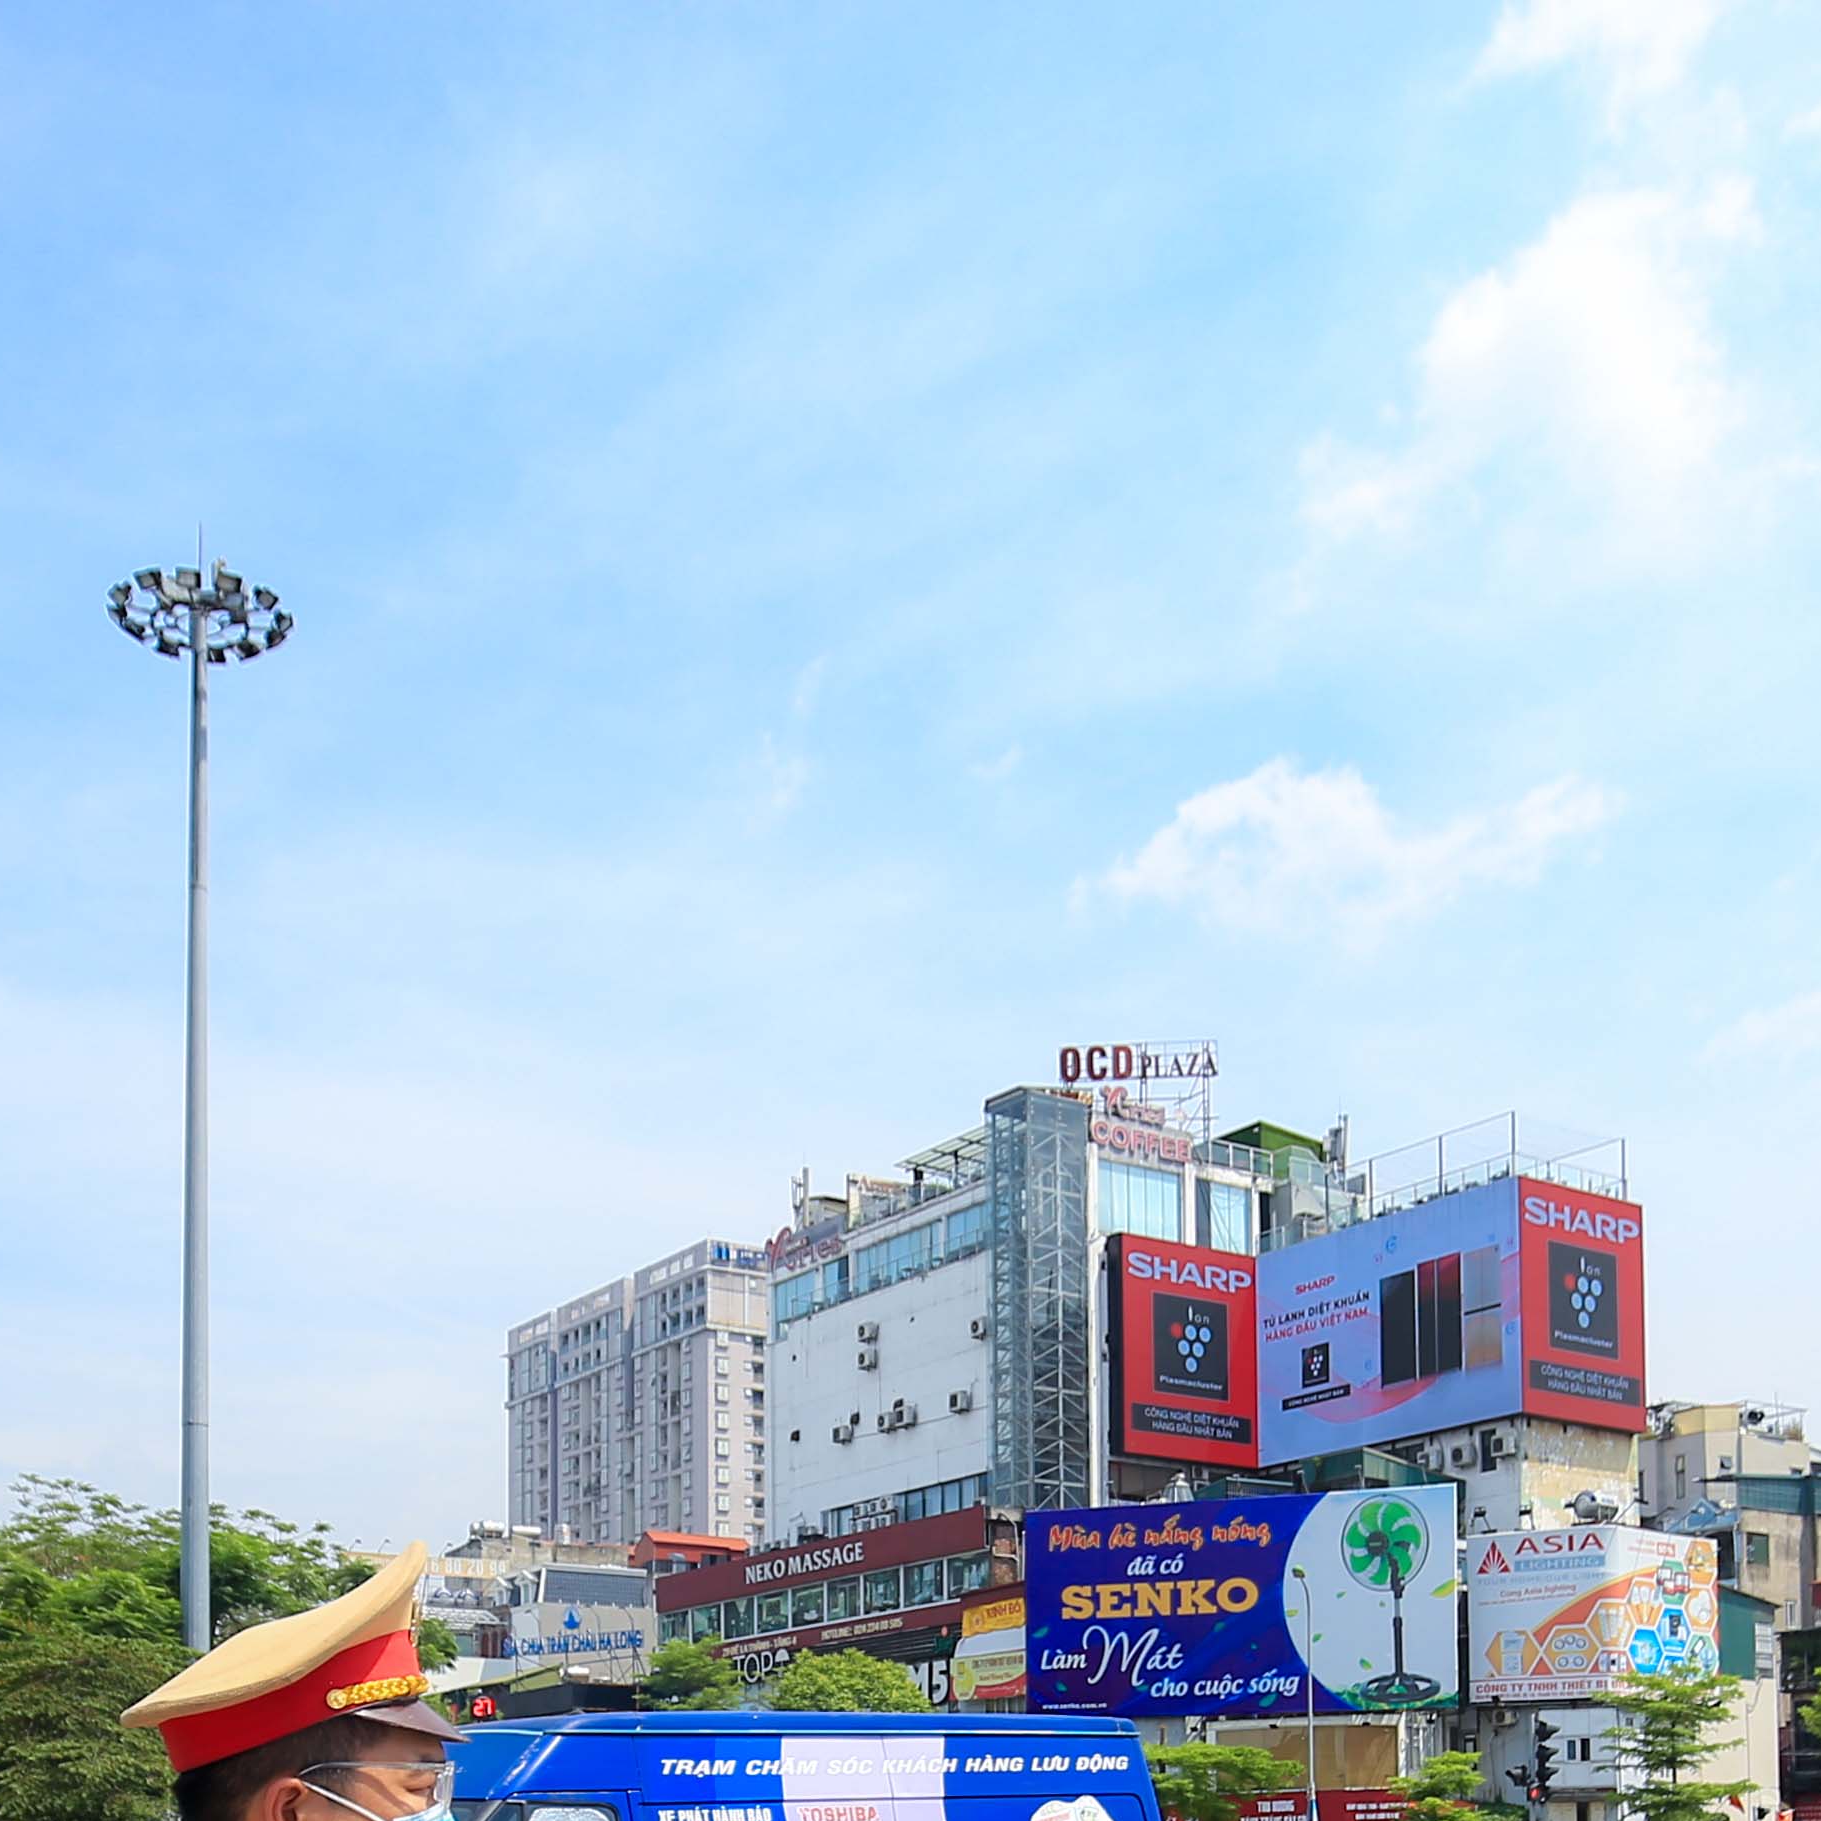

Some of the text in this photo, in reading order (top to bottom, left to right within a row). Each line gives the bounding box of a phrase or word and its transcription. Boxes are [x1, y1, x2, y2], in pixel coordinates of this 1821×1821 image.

[1060, 1045, 1219, 1082] OCD PLAZA
[1093, 1121, 1192, 1163] COFFEE
[1524, 1196, 1640, 1244] SHARP
[1127, 1251, 1252, 1293] SHARP
[1295, 1275, 1335, 1295] SHARP
[1344, 1306, 1369, 1323] NAM
[1554, 1329, 1613, 1349] Plasmacluster
[1160, 1374, 1223, 1391] Plasmacluster
[1049, 1514, 1271, 1552] Mùa hè nắng nóng
[1515, 1532, 1605, 1556] ASIA
[744, 1541, 865, 1585] NEKO MASSAGE
[1126, 1553, 1184, 1576] đã có
[1520, 1556, 1601, 1572] LIGHTING
[1061, 1577, 1259, 1620] SENKO
[1041, 1625, 1183, 1687] Làm Mát
[1150, 1668, 1299, 1698] cho cuộc sống
[1476, 1681, 1507, 1694] CÔNG
[1512, 1682, 1524, 1692] TY
[660, 1752, 1128, 1779] TRẠM CHĂM SÓC KHÁCH HÀNG LƯU ĐỘNG
